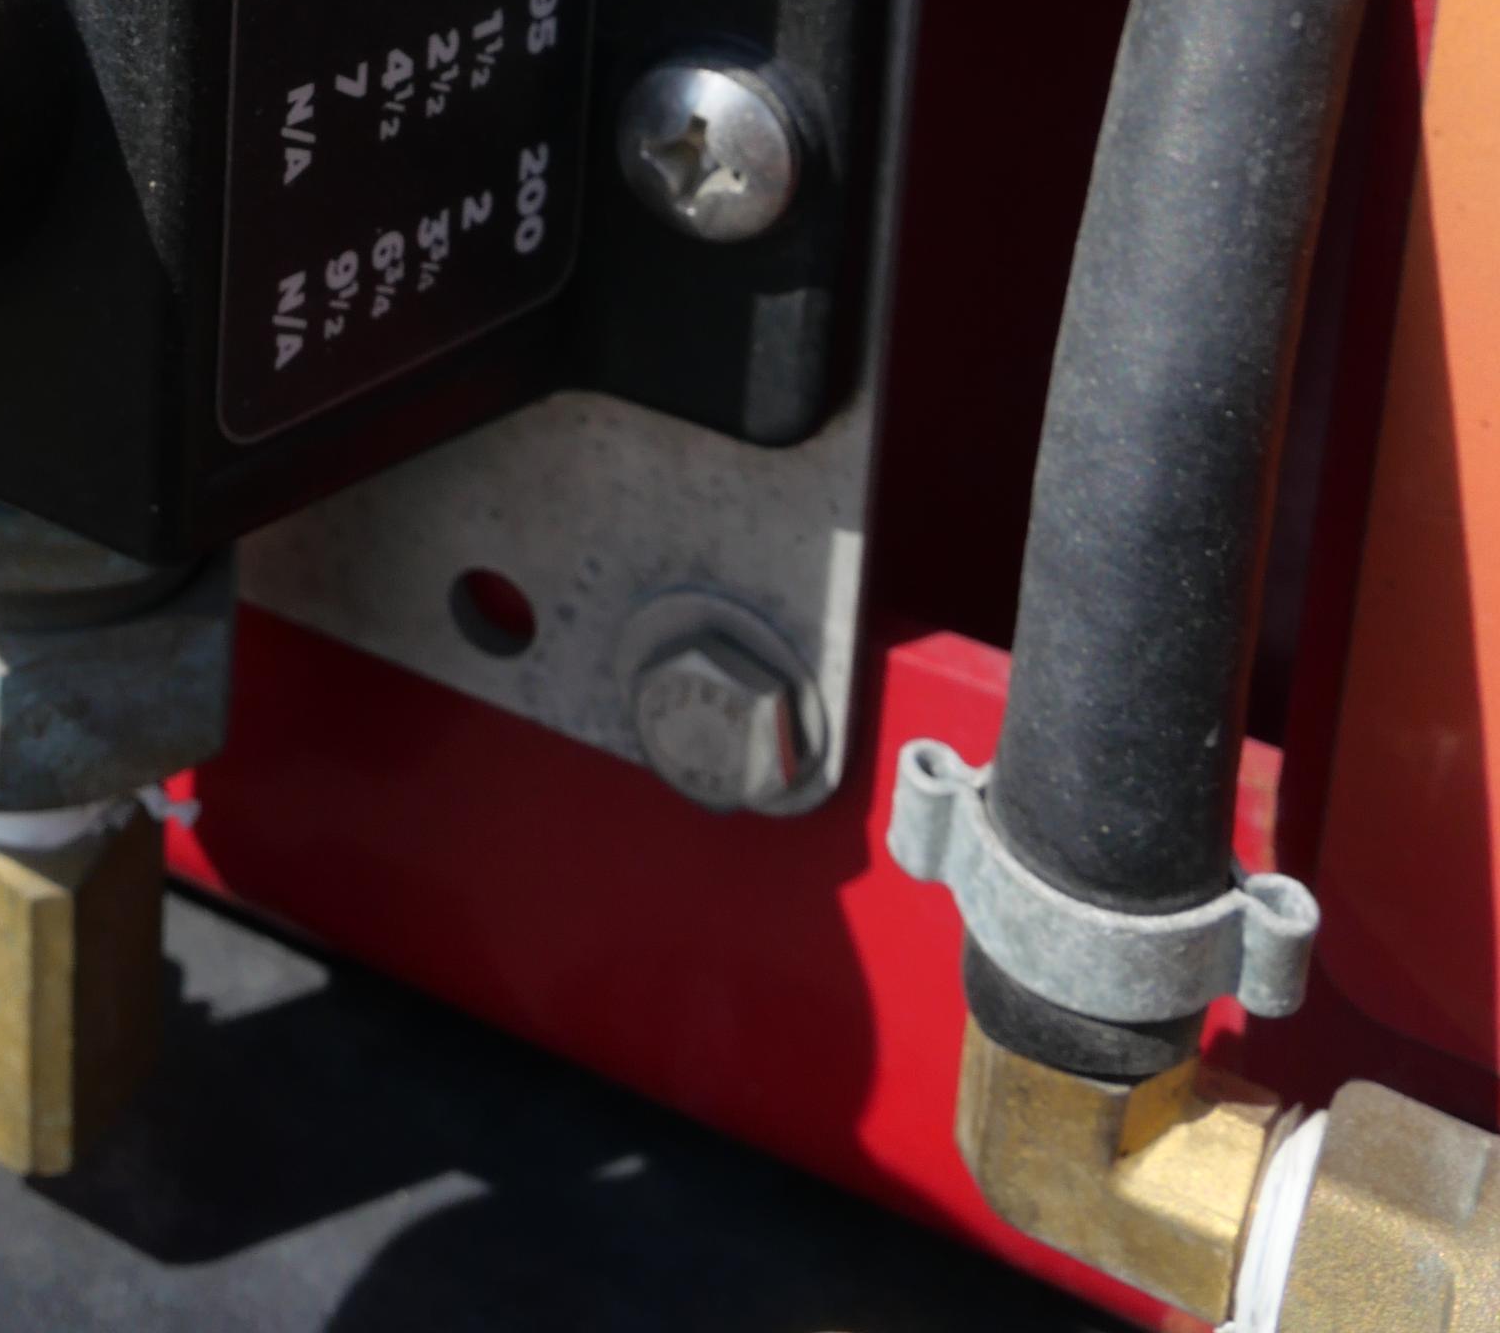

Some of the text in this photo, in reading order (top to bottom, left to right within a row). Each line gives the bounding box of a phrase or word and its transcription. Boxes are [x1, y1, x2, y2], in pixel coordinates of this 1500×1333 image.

[334, 61, 368, 99] 7
[282, 82, 317, 186] N/A
[461, 191, 493, 230] 2
[514, 143, 549, 255] 200
[272, 271, 308, 370] N/A
